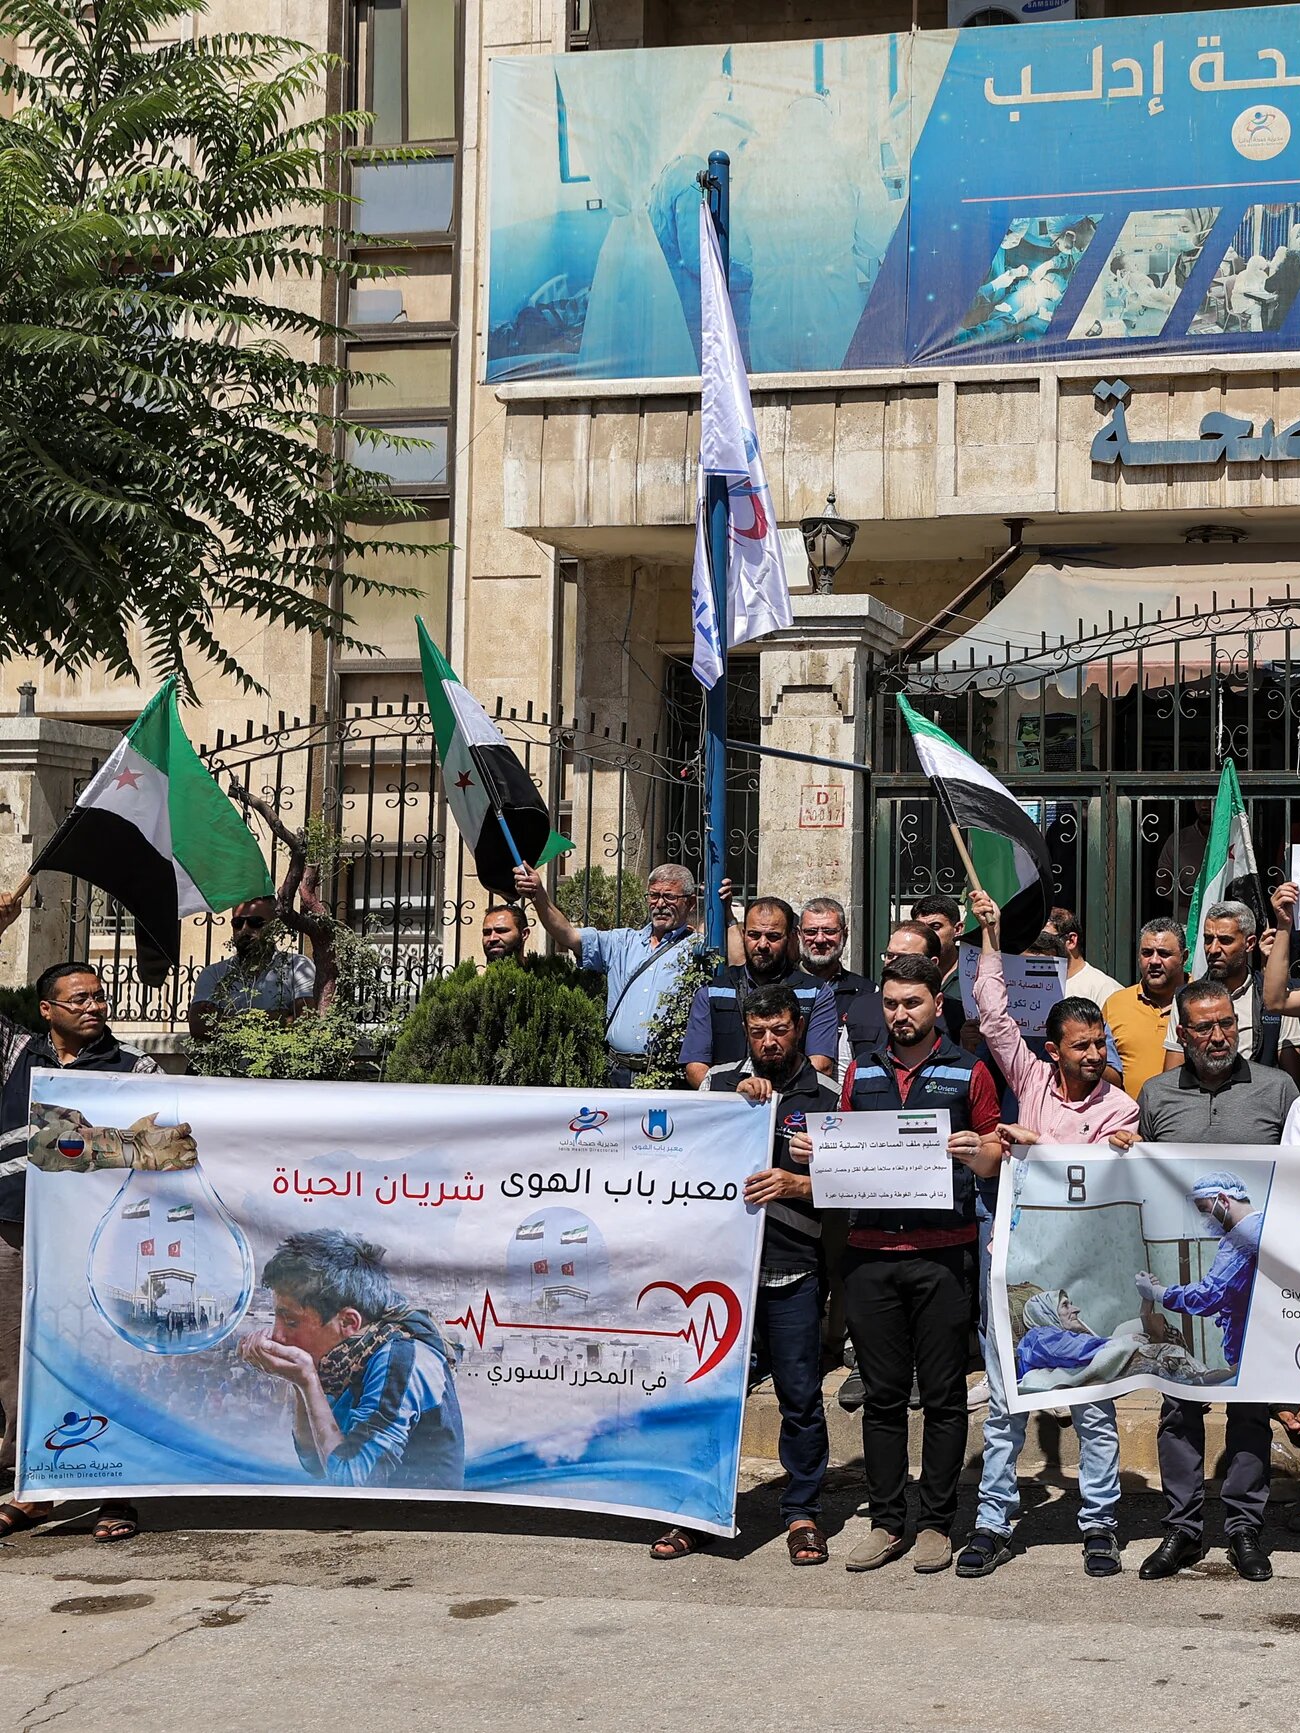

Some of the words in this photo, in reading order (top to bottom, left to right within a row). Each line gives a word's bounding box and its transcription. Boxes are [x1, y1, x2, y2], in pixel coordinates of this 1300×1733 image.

[983, 41, 1165, 122] إدلب
[1030, 1000, 1040, 1010] لن
[818, 1142, 837, 1152] للنظام
[869, 1140, 903, 1148] المساعدات
[906, 1139, 920, 1147] ملف
[273, 1168, 362, 1203] الحياة
[375, 1172, 484, 1208] شريان
[501, 1168, 590, 1198] الهوى
[604, 1171, 656, 1205] باب
[662, 1177, 739, 1207] معبر
[487, 1365, 564, 1386] السوري
[569, 1368, 634, 1387] المحرر
[642, 1371, 667, 1396] في
[29, 1462, 54, 1472] إدلب
[58, 1462, 86, 1470] صحة
[89, 1460, 123, 1471] مديرية
[49, 1472, 74, 1480] Health
[77, 1471, 122, 1479] Directorate
